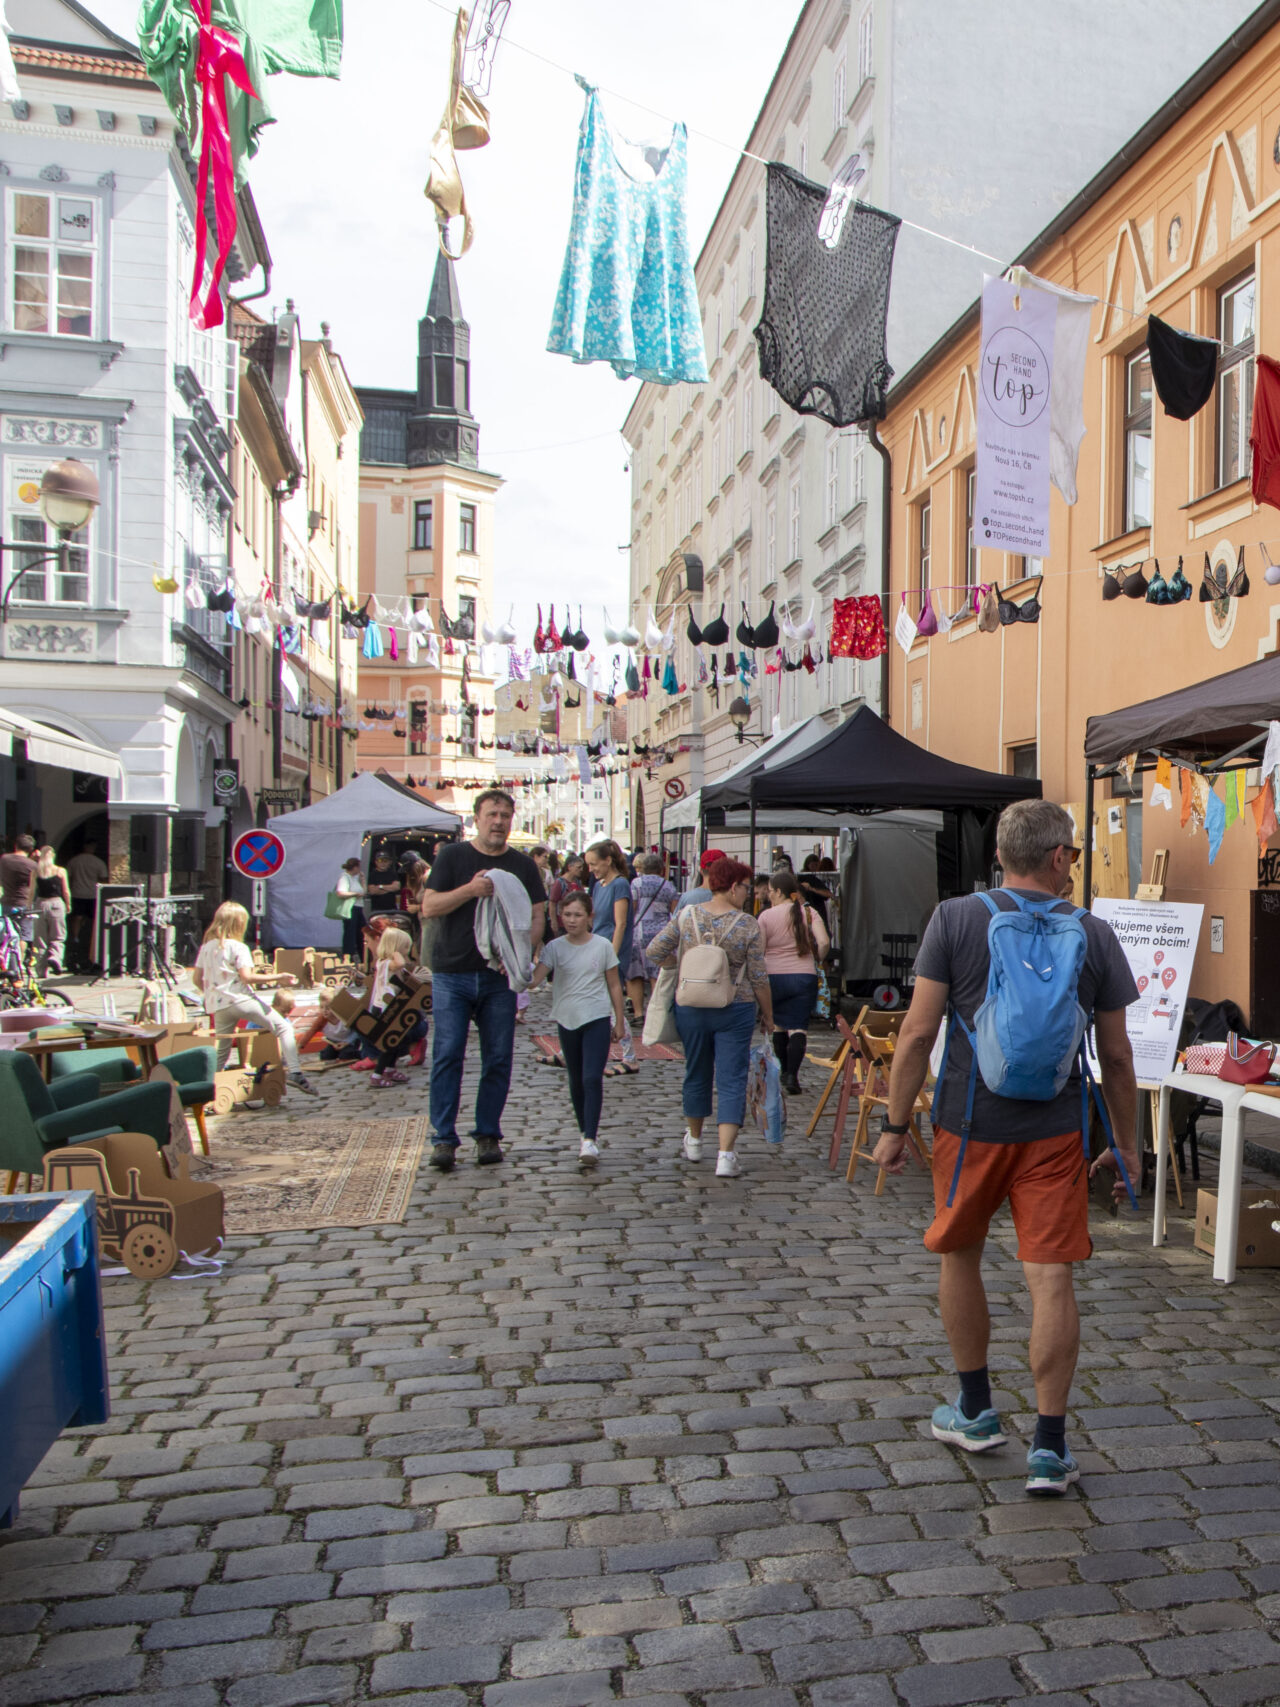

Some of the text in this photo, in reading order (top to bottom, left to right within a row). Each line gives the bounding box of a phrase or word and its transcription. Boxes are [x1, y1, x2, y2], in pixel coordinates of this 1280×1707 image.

[1010, 352, 1037, 368] SECOND
[1013, 365, 1032, 378] HAND
[987, 355, 1044, 416] top
[995, 455, 1010, 466] Nová
[1023, 460, 1032, 471] ČB
[993, 488, 1034, 504] www.topsh.cz
[990, 518, 1044, 536] top_second_hand
[992, 531, 1042, 547] TOPsecondhand
[1103, 919, 1184, 935] ěkujeme všem
[1152, 935, 1190, 948] obcím!
